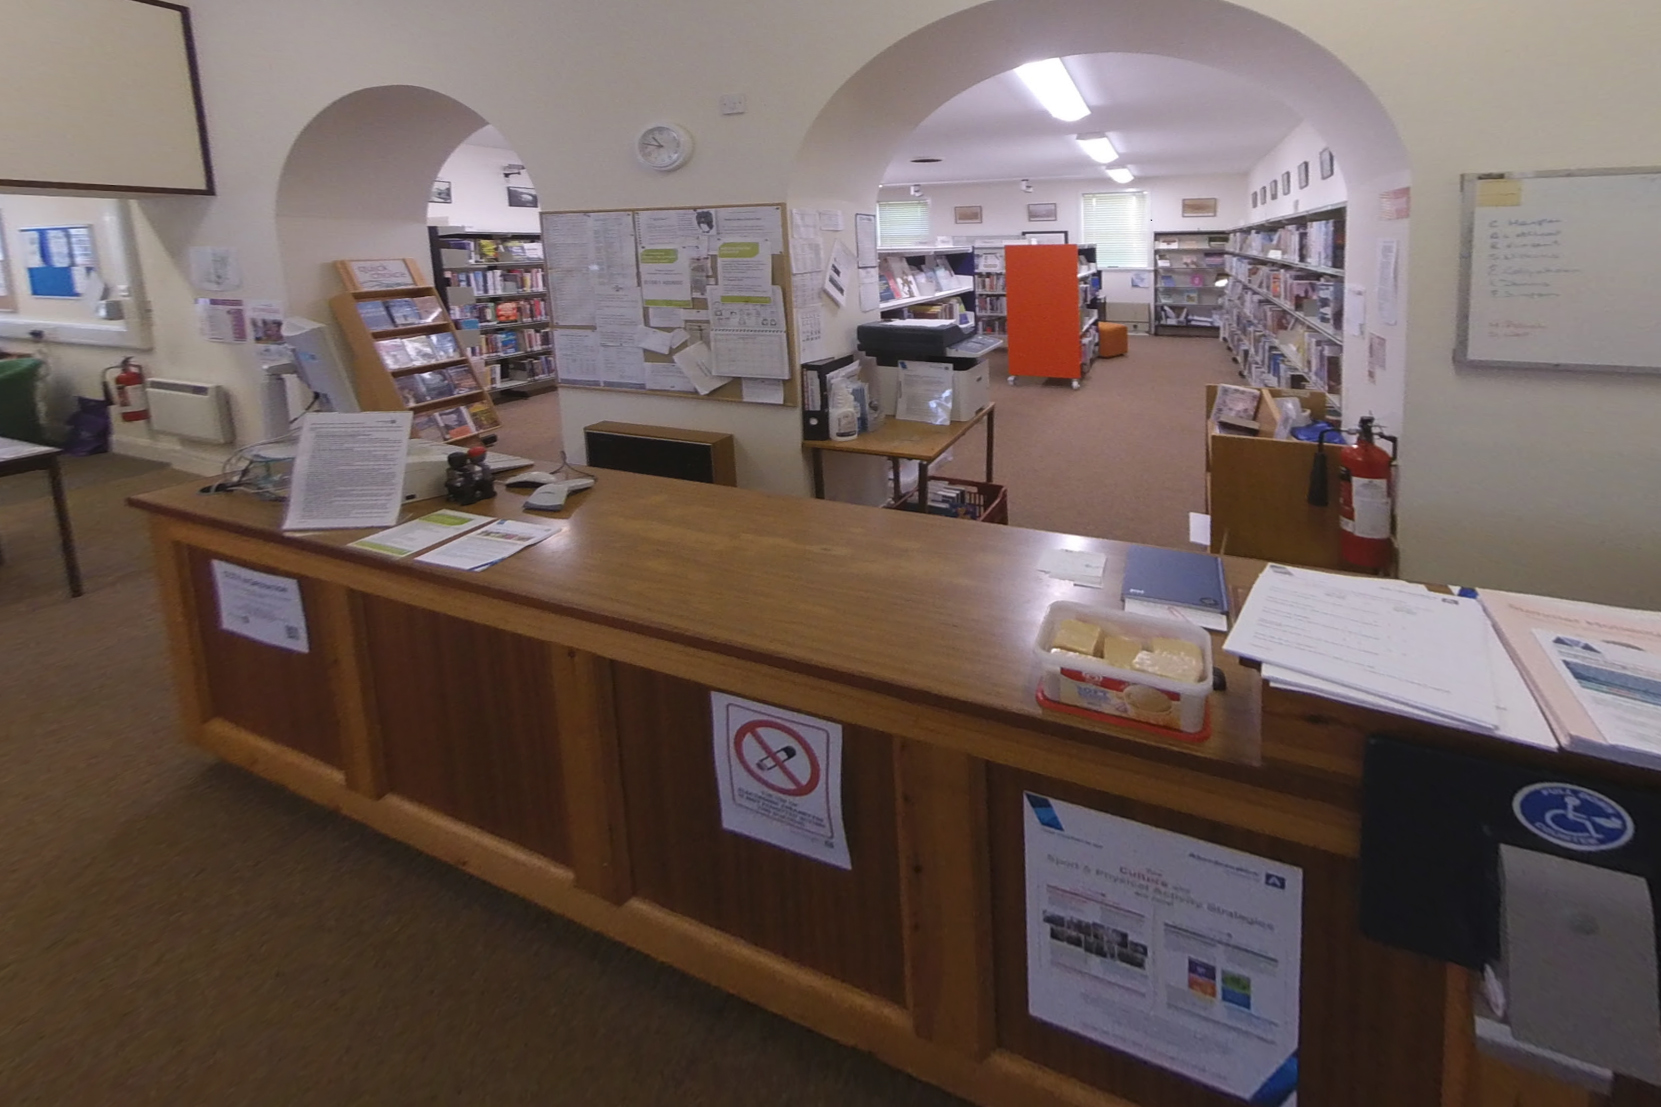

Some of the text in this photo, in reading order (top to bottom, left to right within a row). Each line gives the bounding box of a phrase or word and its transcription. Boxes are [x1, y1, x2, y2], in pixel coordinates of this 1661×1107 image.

[1047, 853, 1079, 870] Sport
[1095, 867, 1149, 891] Physical
[1153, 886, 1202, 909] Activity
[1206, 902, 1275, 932] Strategies
[1119, 866, 1168, 887] Culture
